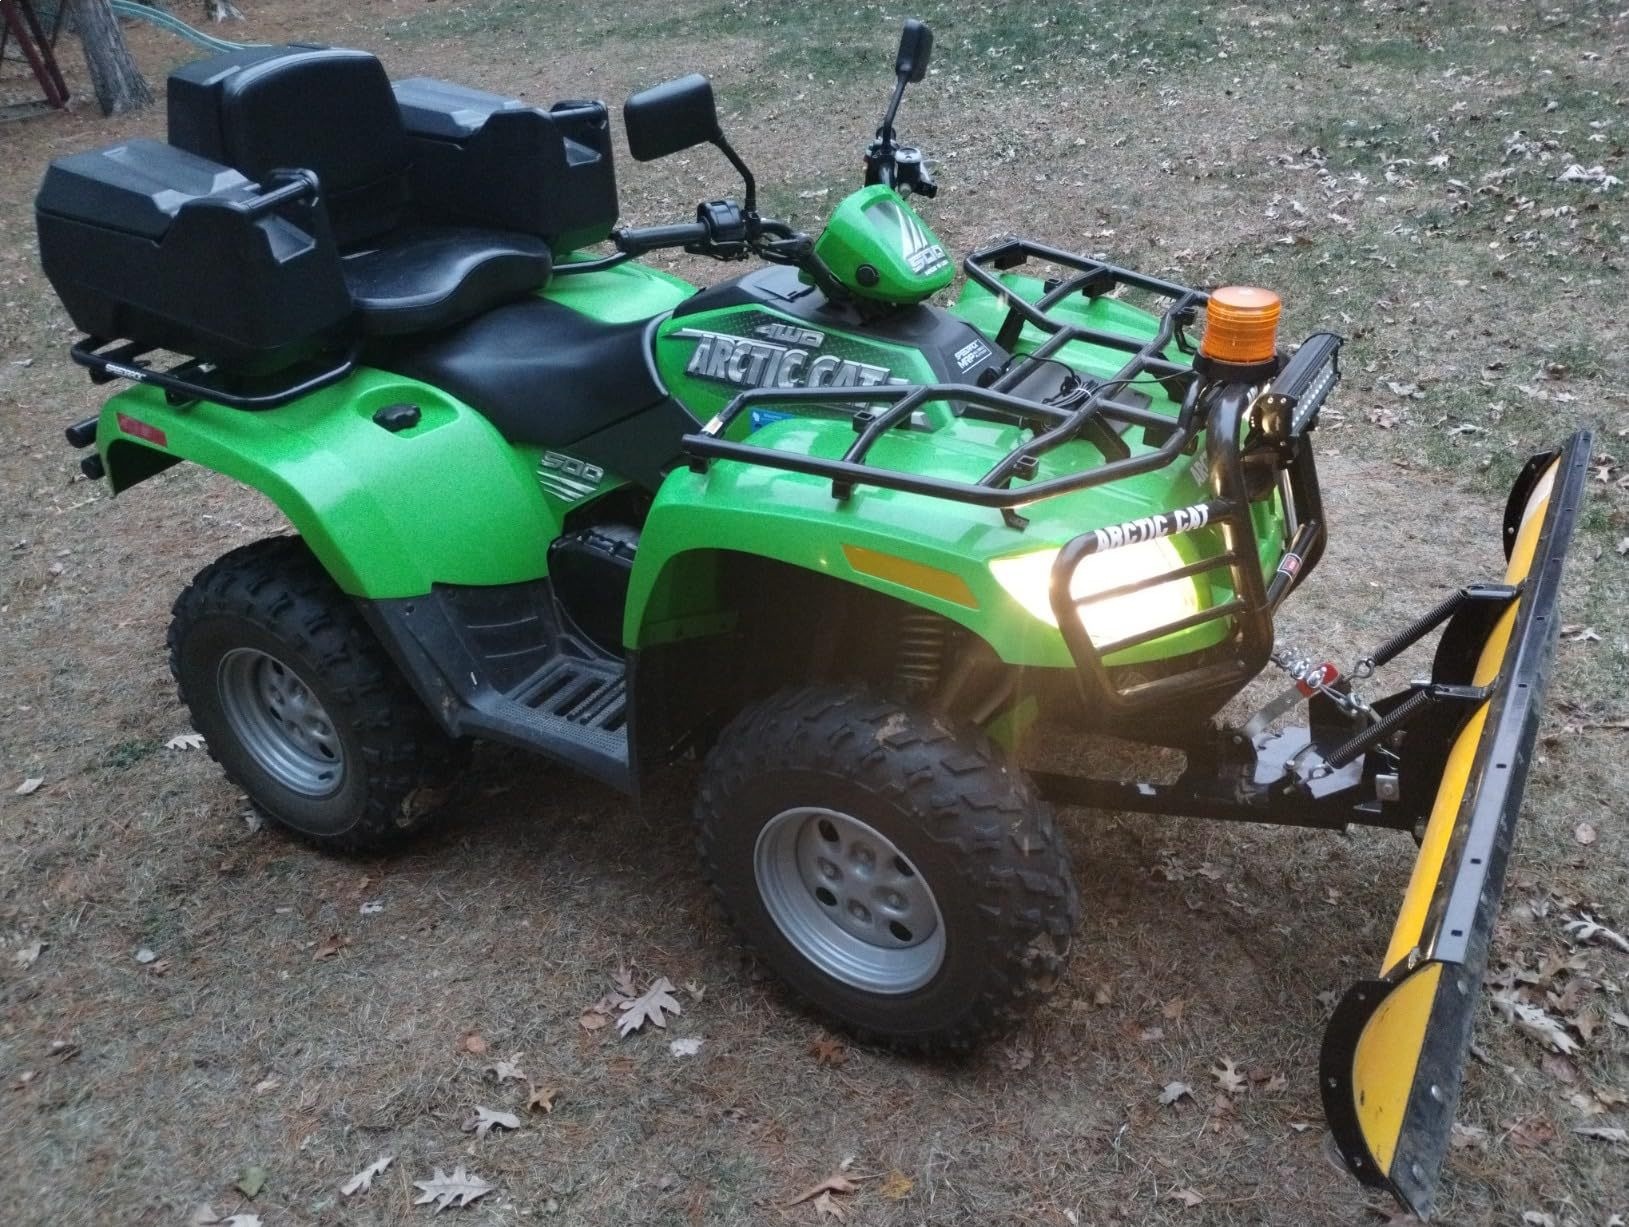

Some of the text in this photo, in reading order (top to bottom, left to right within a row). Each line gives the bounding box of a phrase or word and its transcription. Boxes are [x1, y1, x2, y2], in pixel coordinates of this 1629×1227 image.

[907, 244, 946, 273] 500
[687, 333, 891, 391] ARCTIC CAT
[541, 450, 605, 484] 500
[1094, 503, 1209, 553] ARCTIC CAT
